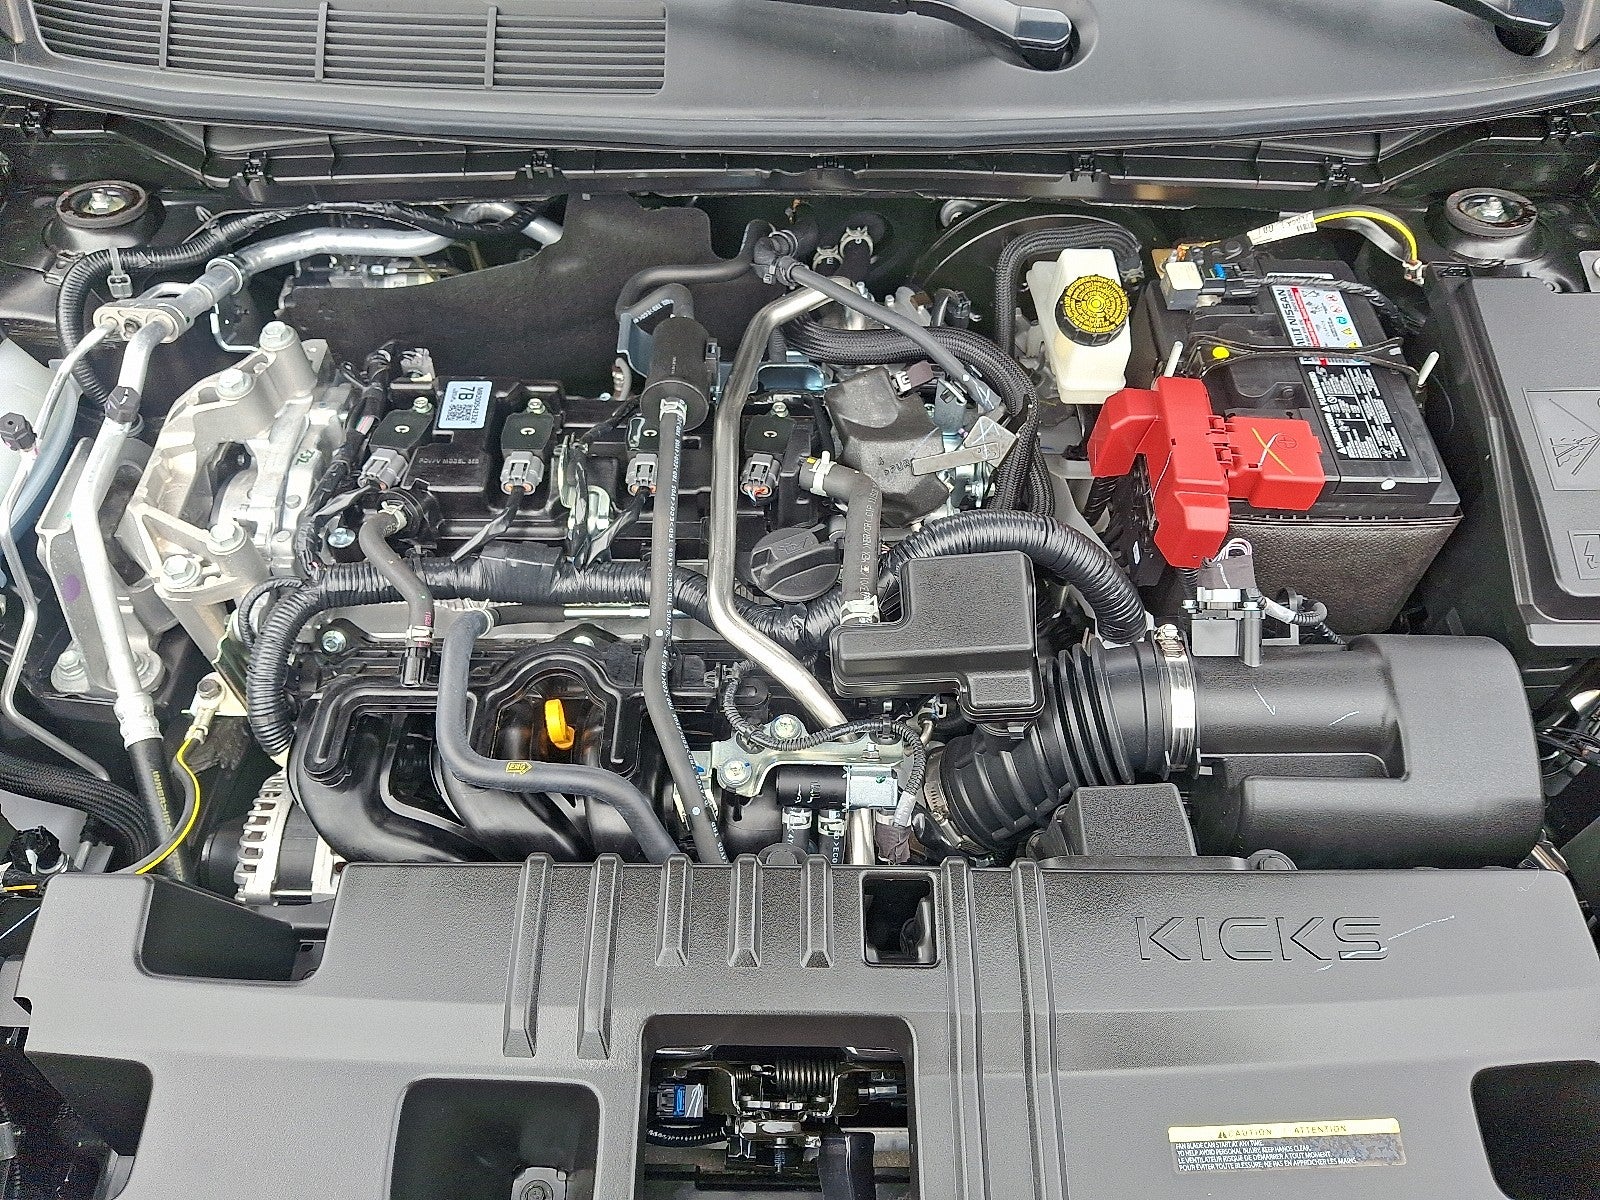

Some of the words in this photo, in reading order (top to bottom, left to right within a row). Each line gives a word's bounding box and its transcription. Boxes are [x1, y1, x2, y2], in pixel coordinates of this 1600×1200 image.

[1276, 288, 1299, 327] NISSAN
[458, 386, 476, 400] 7B
[1135, 916, 1389, 962] KICKS
[1228, 1128, 1272, 1138] CAUTION
[1294, 1125, 1347, 1134] ATTENTION
[1176, 1142, 1187, 1150] FAN
[1204, 1141, 1215, 1149] CAN
[1177, 1150, 1185, 1158] TO
[1215, 1147, 1241, 1155] PERSONAL
[1186, 1155, 1223, 1163] VENTILATEUR
[1223, 1154, 1243, 1162] RISQUE
[1263, 1160, 1272, 1168] NE
[1283, 1159, 1292, 1167] EN
[1292, 1158, 1327, 1166] APPROCHER
[1327, 1157, 1337, 1165] LES
